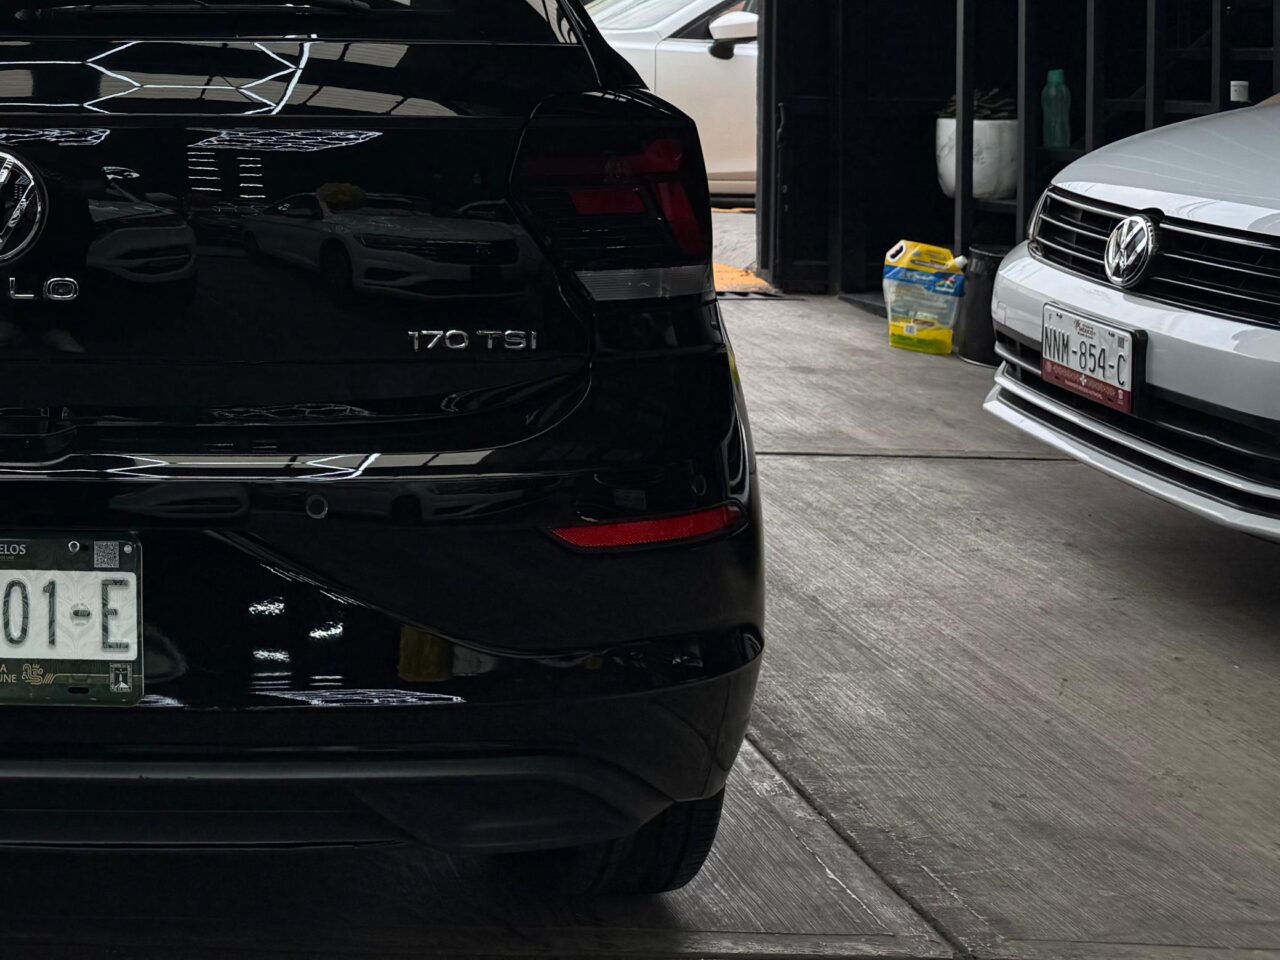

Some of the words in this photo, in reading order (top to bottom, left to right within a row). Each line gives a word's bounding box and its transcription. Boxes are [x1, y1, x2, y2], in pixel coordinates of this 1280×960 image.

[408, 330, 469, 352] 170
[476, 330, 537, 350] TSI
[1045, 326, 1126, 387] NNM-854-C
